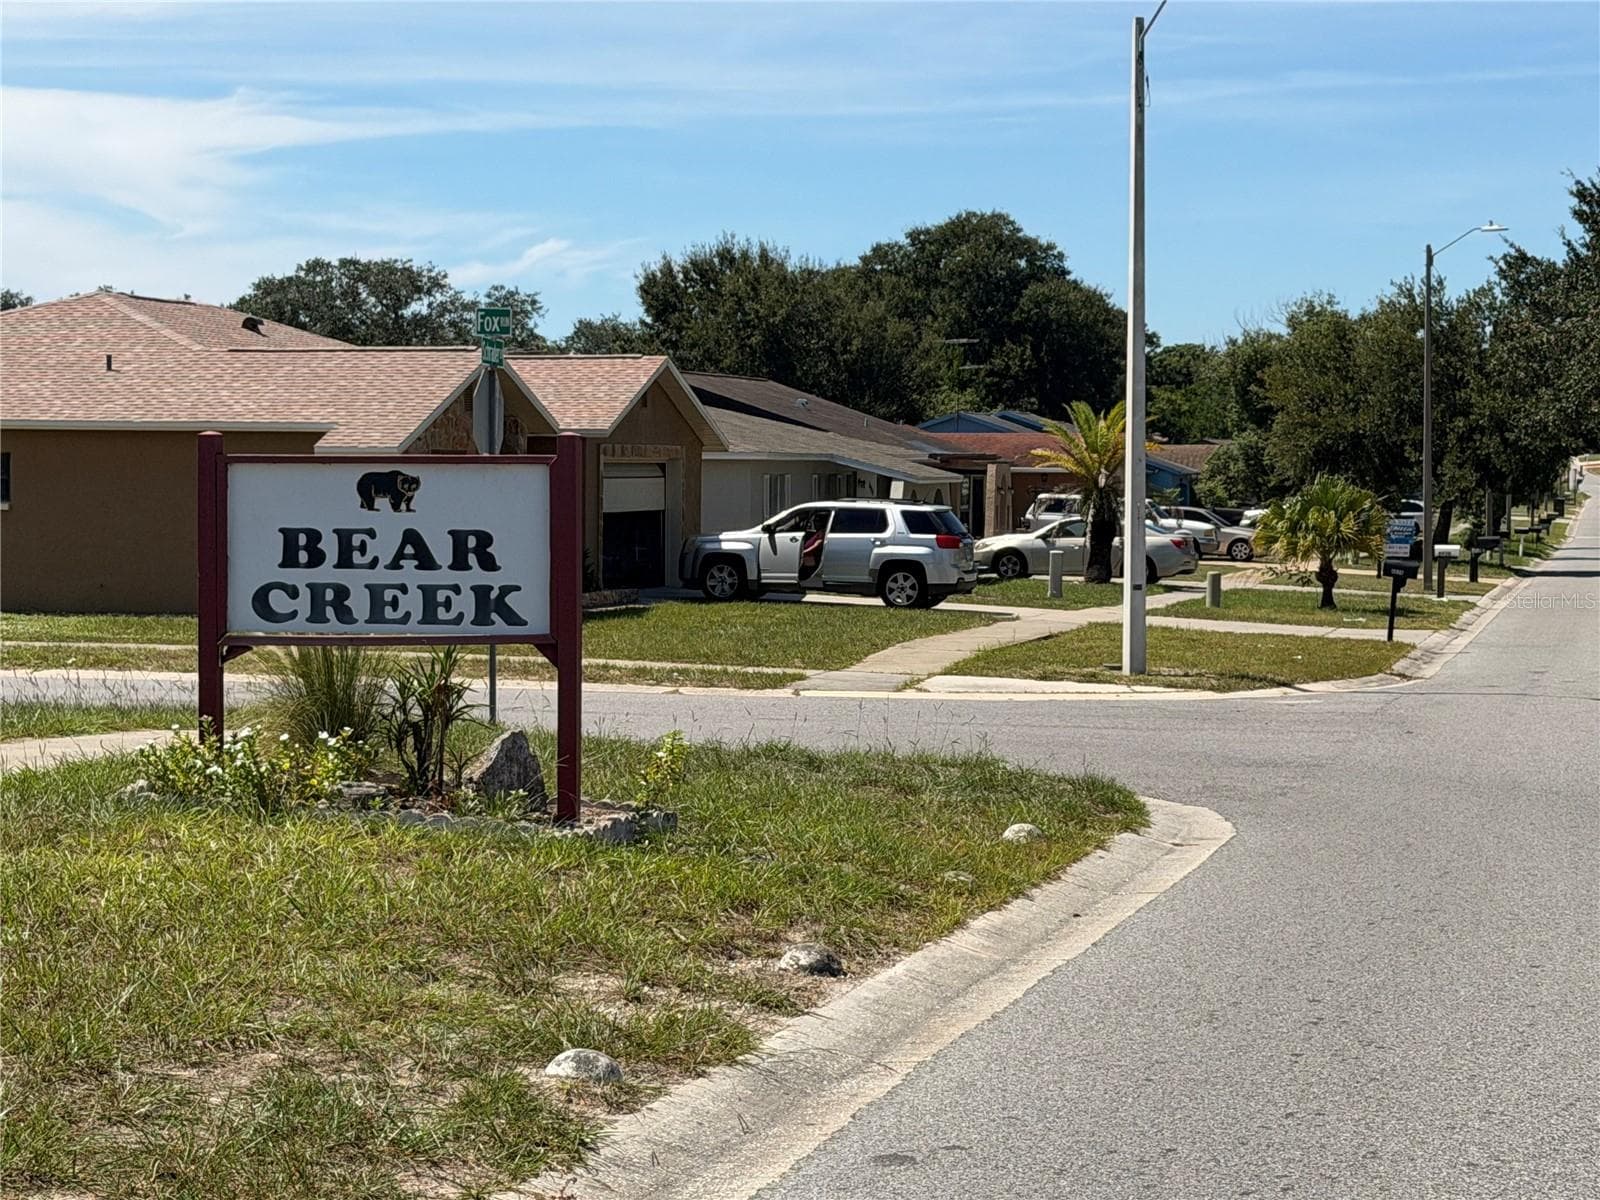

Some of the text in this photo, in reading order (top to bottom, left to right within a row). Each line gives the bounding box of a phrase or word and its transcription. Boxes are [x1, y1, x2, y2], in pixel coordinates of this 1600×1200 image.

[478, 311, 501, 332] Fox
[277, 527, 502, 572] BEAR
[251, 581, 529, 627] CREEK
